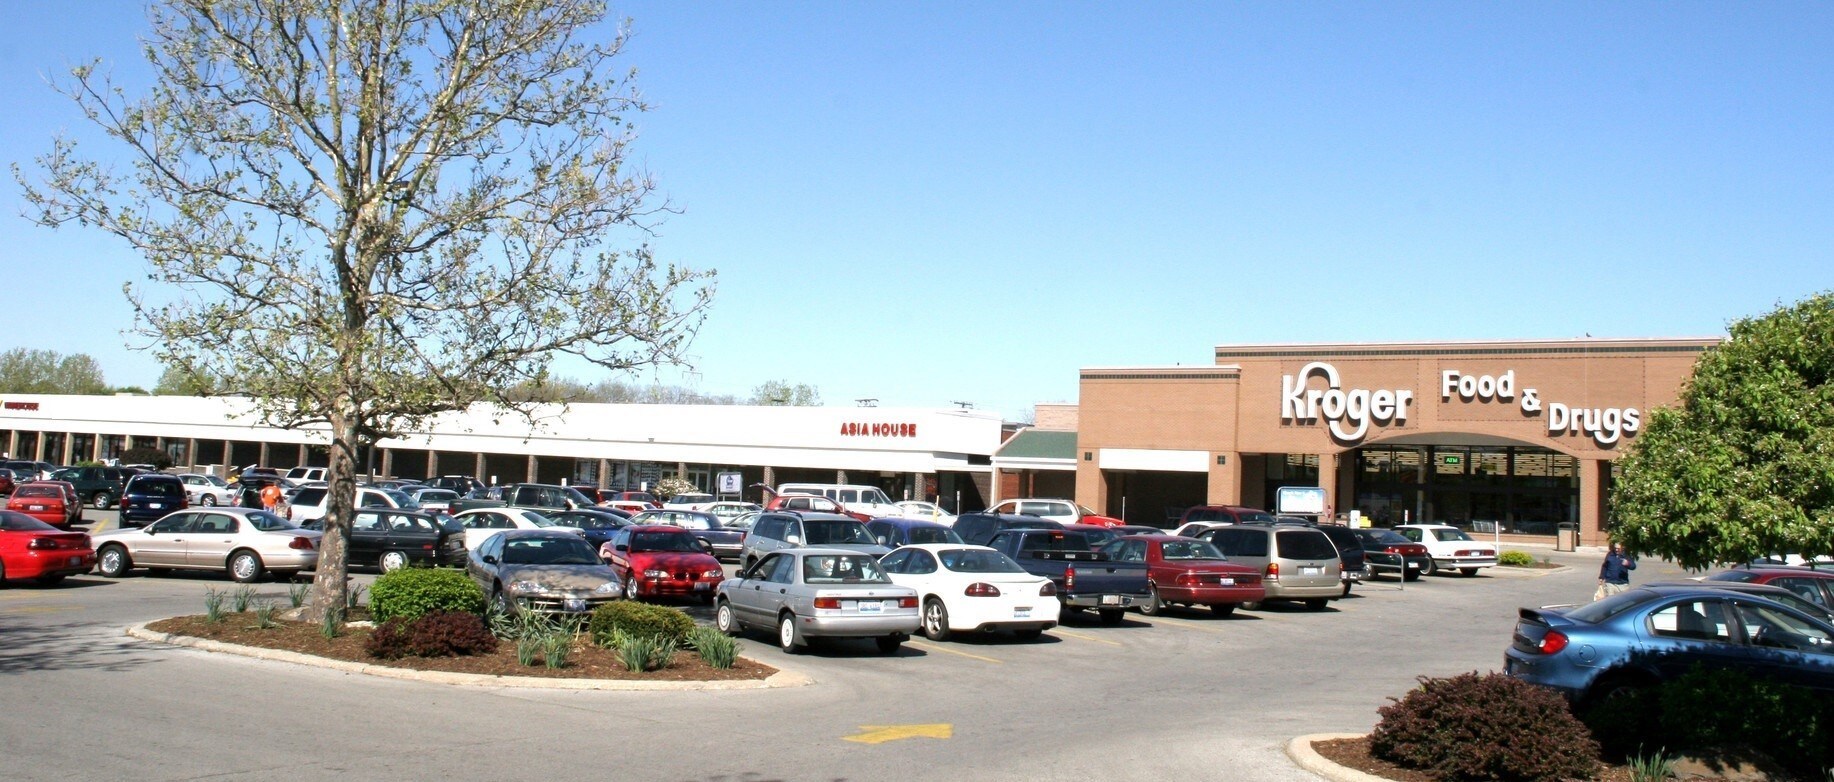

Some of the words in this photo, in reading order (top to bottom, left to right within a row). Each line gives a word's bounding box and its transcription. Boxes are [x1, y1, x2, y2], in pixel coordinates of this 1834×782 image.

[840, 422, 869, 436] ASIA
[872, 422, 917, 438] HOUSE
[1281, 361, 1413, 441] Kroger
[1441, 369, 1515, 400] Food
[1520, 388, 1542, 412] &
[1548, 402, 1640, 444] Drugs
